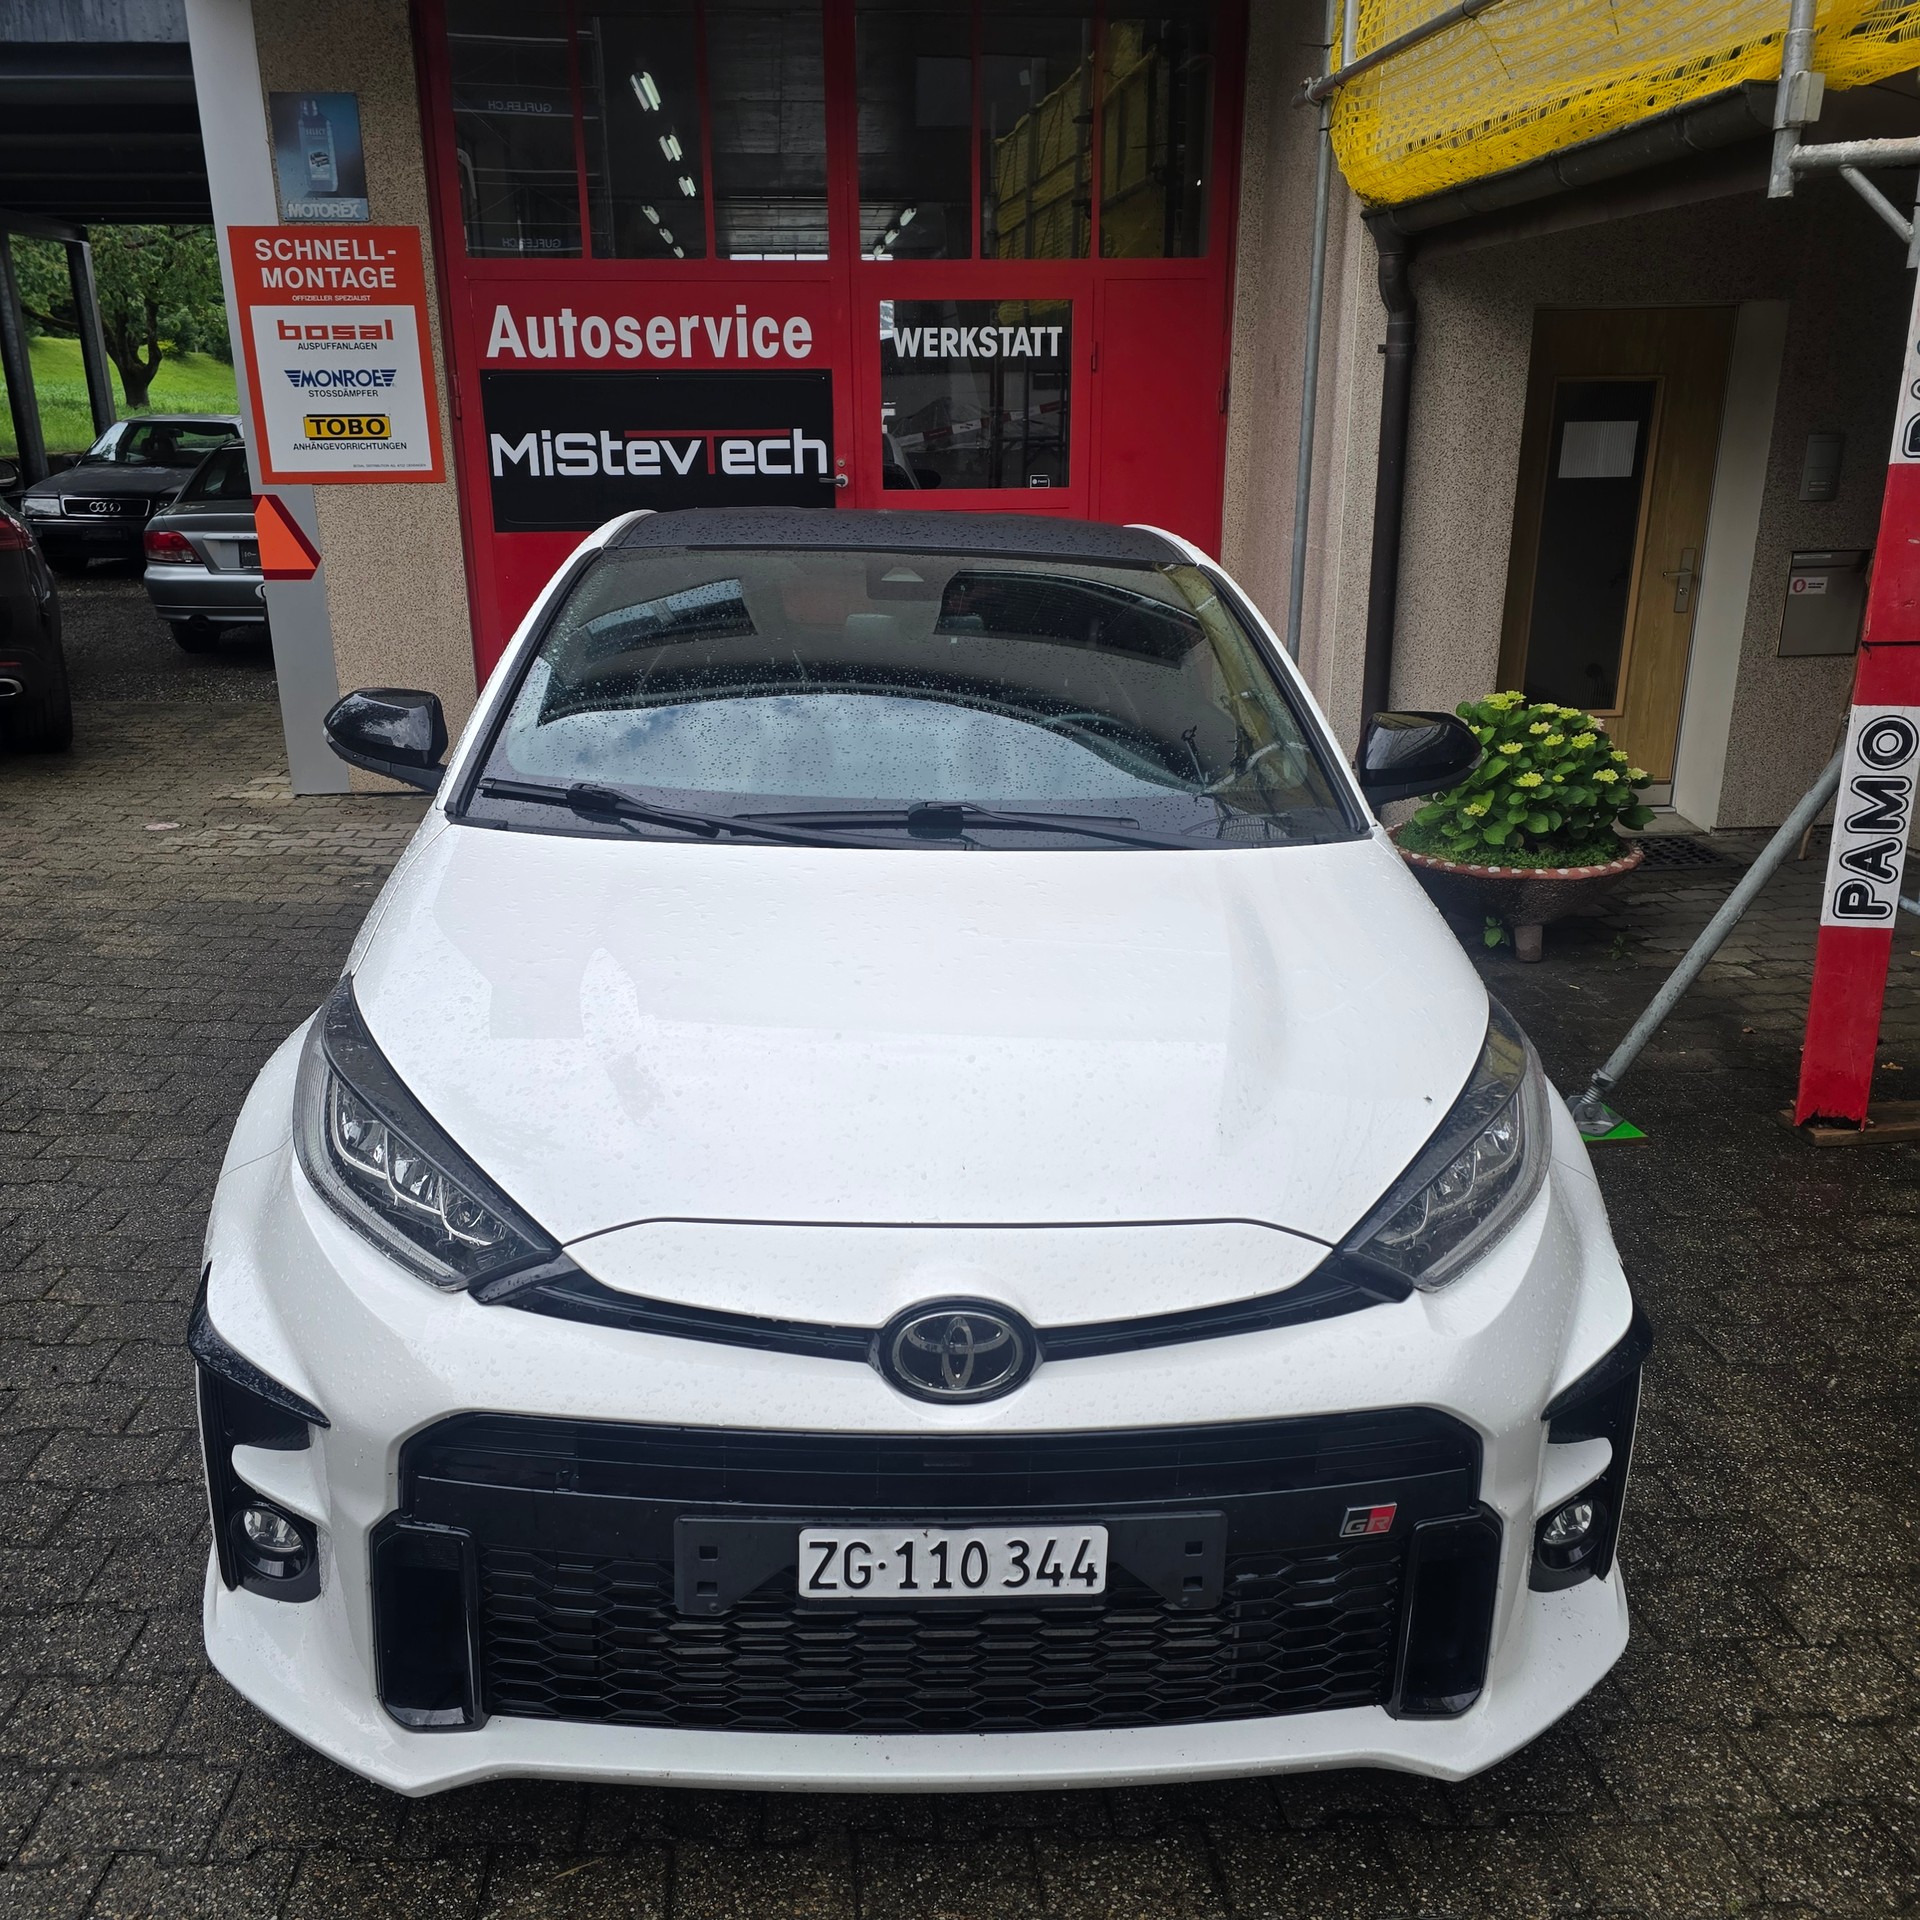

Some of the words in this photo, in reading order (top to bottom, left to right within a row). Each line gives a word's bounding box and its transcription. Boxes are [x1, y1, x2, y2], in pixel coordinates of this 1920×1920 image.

[287, 203, 361, 218] MOTOREX
[254, 238, 398, 262] SCHNELL-
[261, 266, 397, 289] MONTAGE
[291, 294, 333, 302] OFFIZIELLER
[334, 294, 371, 302] SPEZIALIST
[276, 319, 394, 341] bosal
[486, 304, 813, 359] Autoservice
[297, 342, 378, 351] AUSPUFFANLAGEN
[893, 326, 1063, 358] WERKSTATT
[300, 368, 385, 388] MONROE
[308, 389, 379, 398] STOSSDÄMPFER
[309, 418, 386, 436] TOBO
[293, 441, 407, 451] ANHÄNGEVORRICHTUNGEN
[489, 428, 829, 477] MiStevTech
[1833, 714, 1919, 920] PAMO
[1344, 1516, 1391, 1534] GR
[1001, 1539, 1098, 1588] 344
